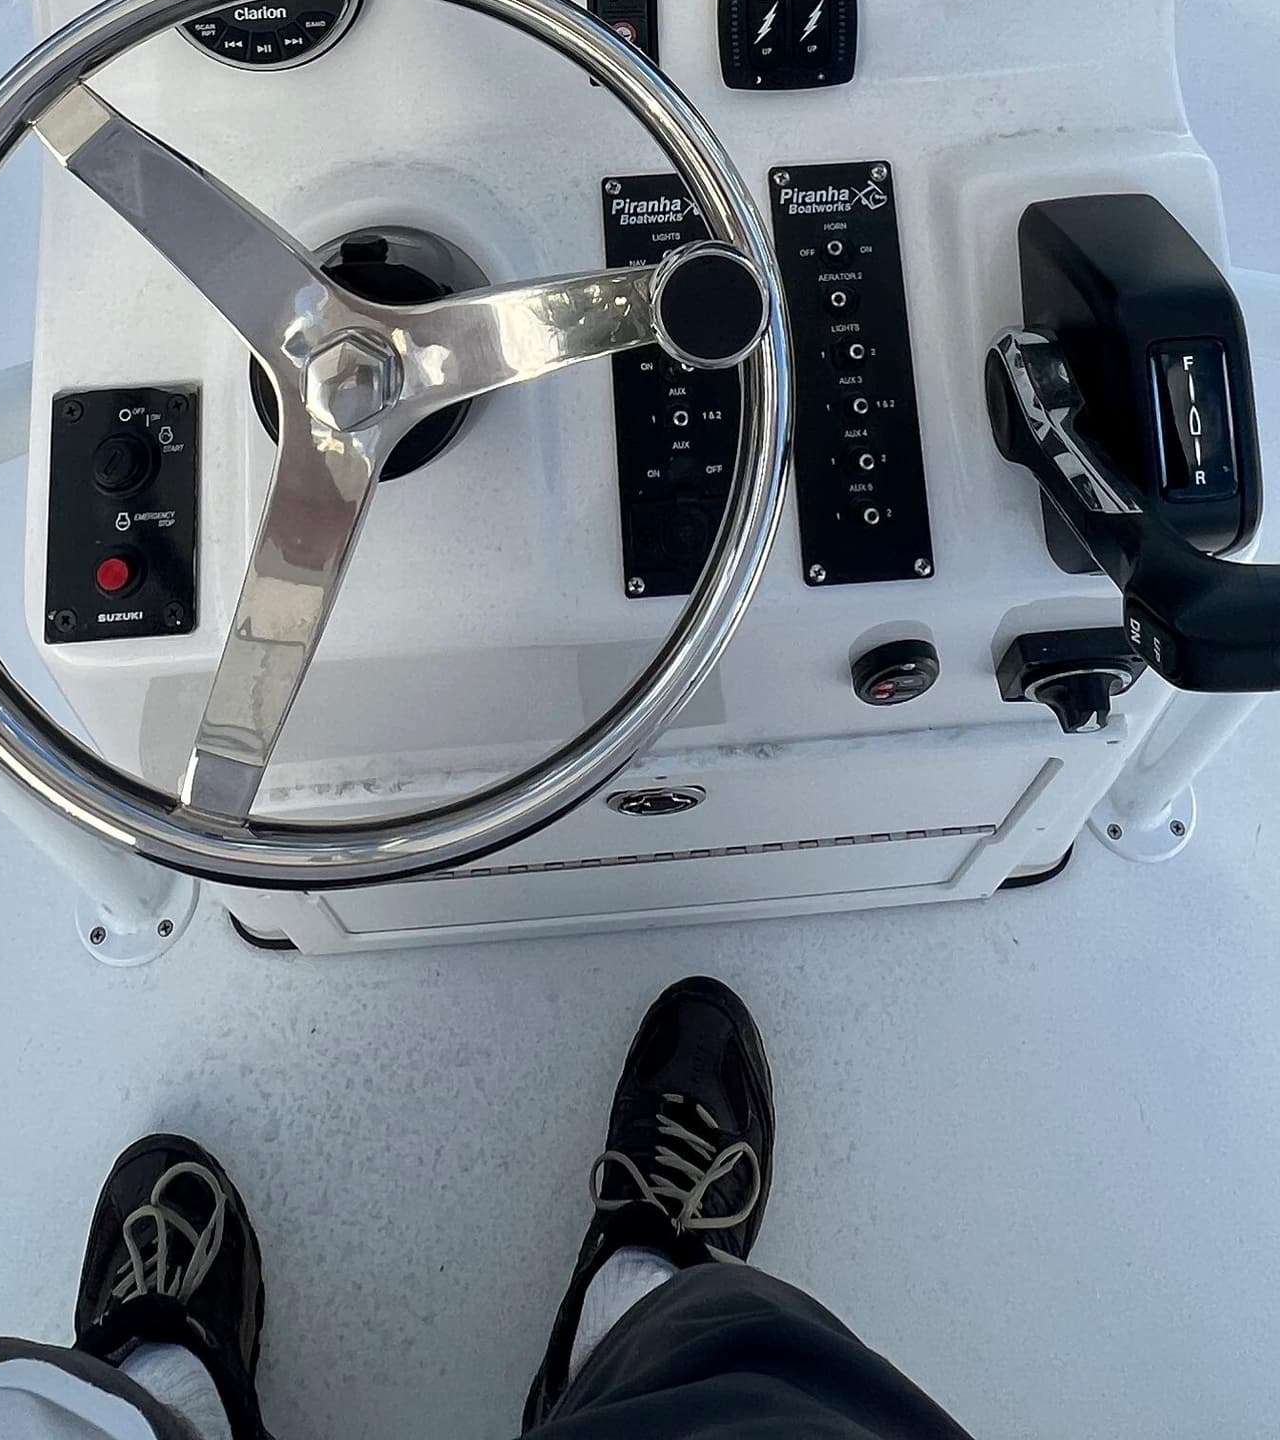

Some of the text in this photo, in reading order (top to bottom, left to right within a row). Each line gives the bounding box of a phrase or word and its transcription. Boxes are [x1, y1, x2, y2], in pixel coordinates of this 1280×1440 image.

[762, 47, 772, 55] UP
[807, 45, 817, 53] UP
[780, 185, 849, 205] Piranha
[611, 196, 681, 215] Piranha
[788, 201, 852, 215] Boatworks
[620, 211, 683, 226] Boatworks
[823, 222, 847, 231] HORN
[652, 232, 681, 242] LIGHTS
[799, 248, 816, 257] OFF
[860, 246, 873, 254] ON
[629, 259, 647, 267] NAV
[831, 323, 861, 333] LIGHTS
[640, 362, 654, 371] ON
[1183, 356, 1194, 371] F
[839, 377, 857, 385] AUX
[668, 387, 687, 396] AUX
[672, 441, 690, 450] AUX
[647, 469, 661, 478] ON
[706, 464, 723, 474] OFF
[1195, 470, 1207, 485] R
[97, 611, 144, 623] SUZUKI
[1129, 617, 1142, 645] DN
[1153, 636, 1162, 663] UP
